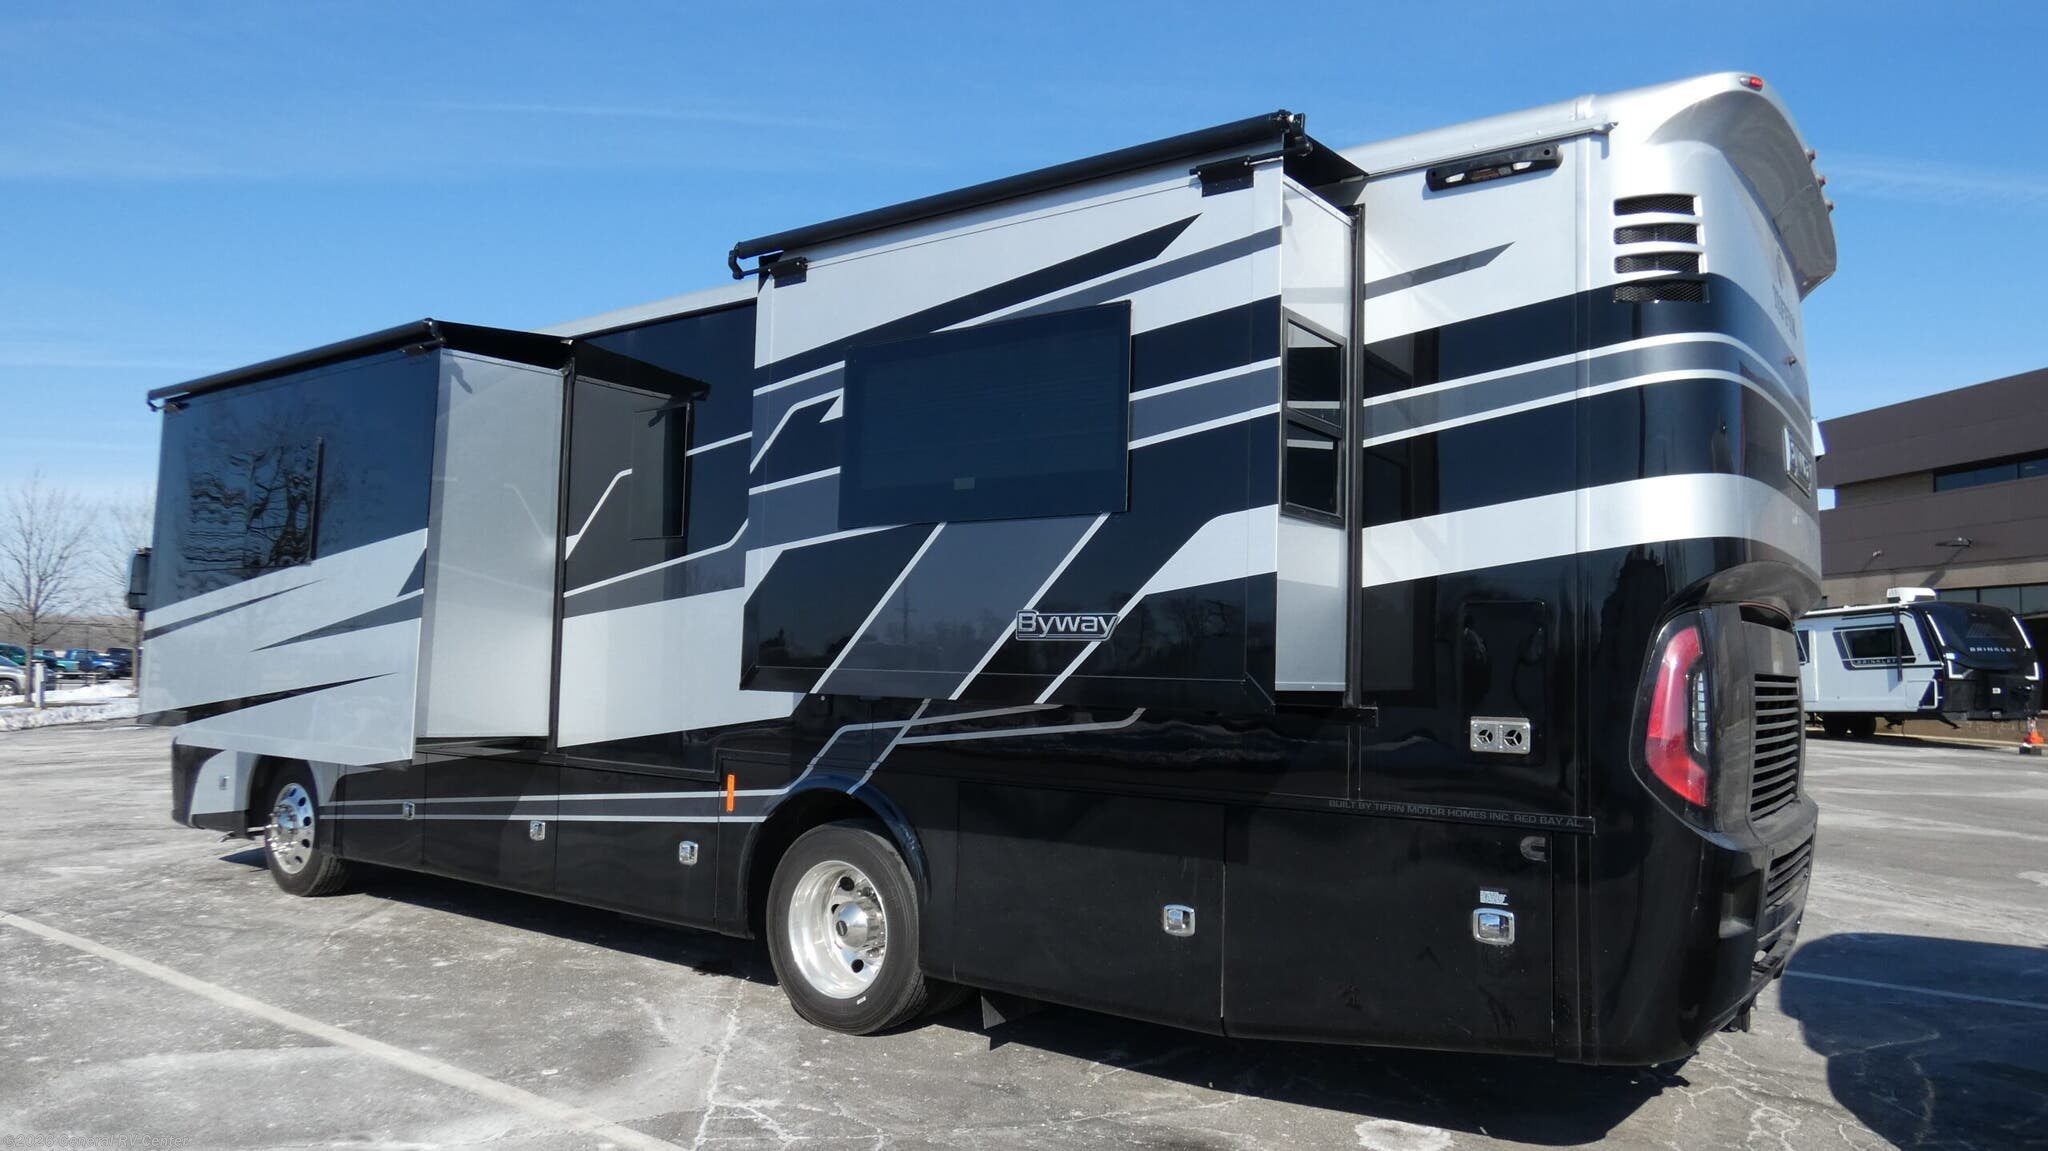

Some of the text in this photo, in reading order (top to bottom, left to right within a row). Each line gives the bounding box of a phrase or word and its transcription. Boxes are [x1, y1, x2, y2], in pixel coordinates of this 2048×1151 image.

[1018, 612, 1118, 637] Byway
[1328, 799, 1355, 809] BUILT
[1358, 801, 1372, 810] BY
[1374, 802, 1405, 813] TIFFIN
[1407, 805, 1446, 817] MOTOR
[1447, 808, 1487, 820] HOMES
[1513, 814, 1537, 824] RED
[1540, 816, 1564, 825] BAY
